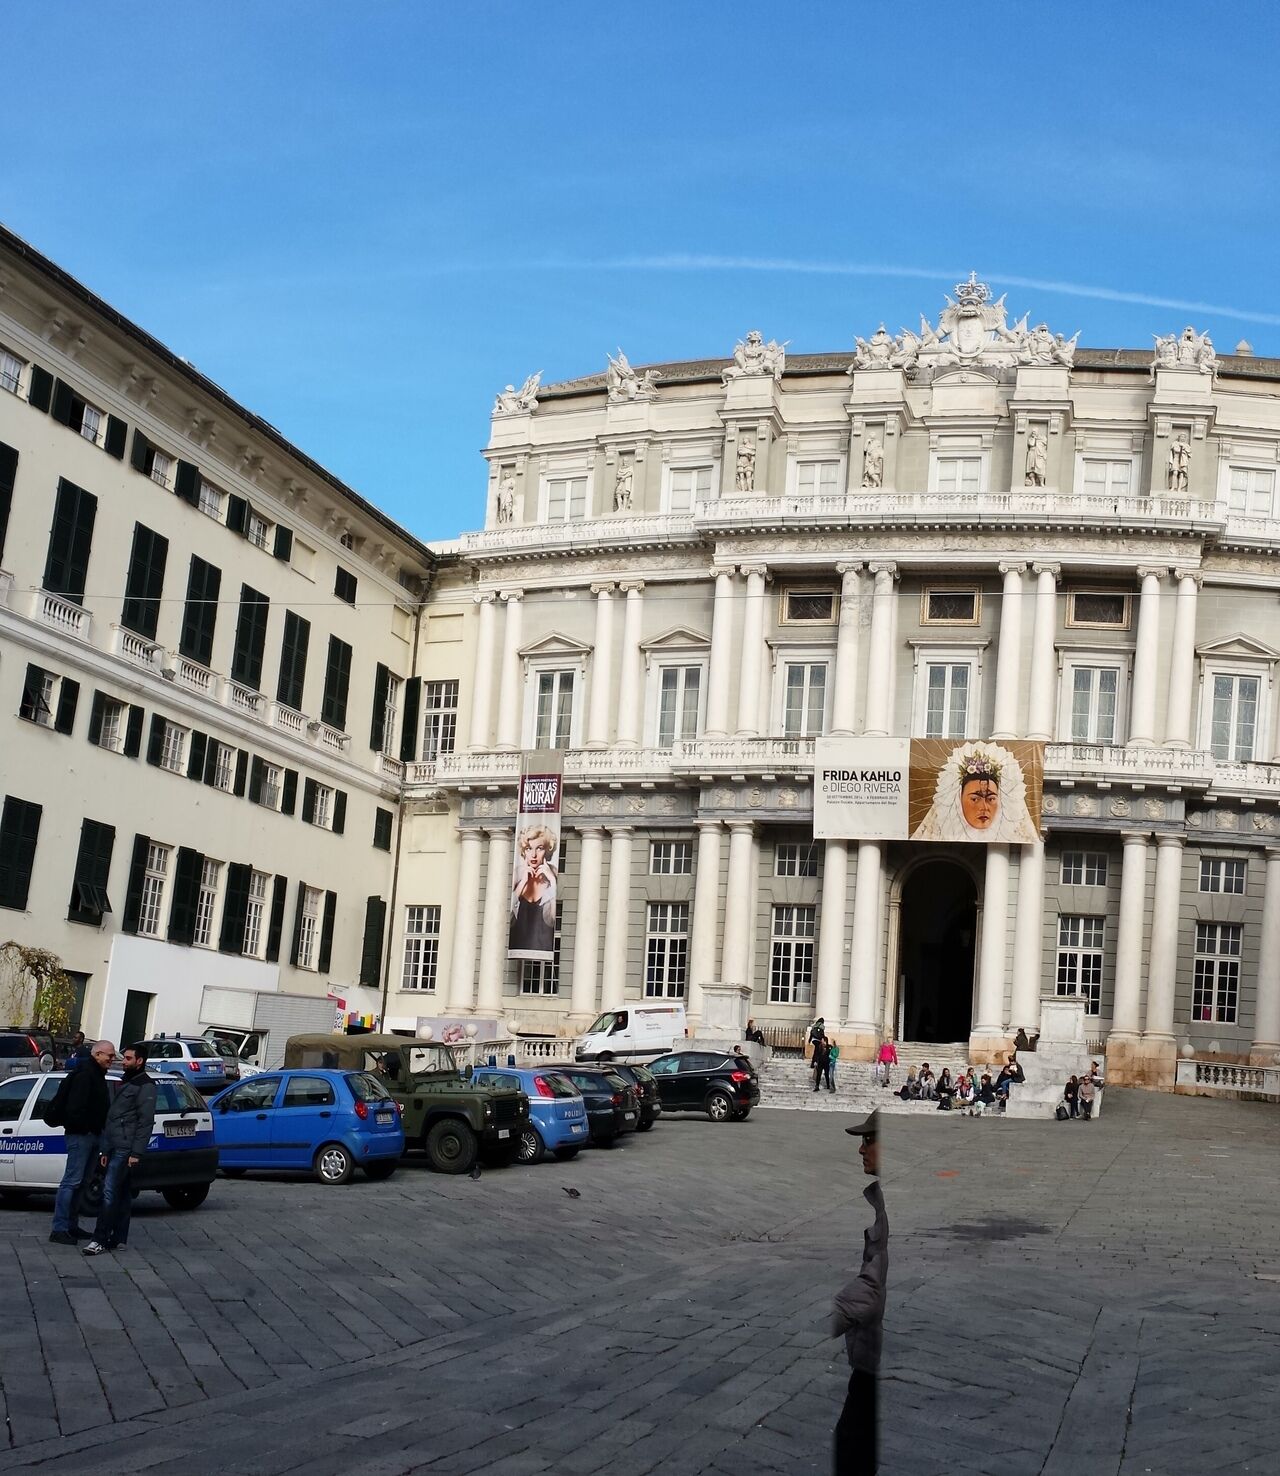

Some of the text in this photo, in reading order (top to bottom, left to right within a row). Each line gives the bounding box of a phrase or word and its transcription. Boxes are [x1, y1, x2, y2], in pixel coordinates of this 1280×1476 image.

[823, 770, 901, 782] FRIDA KAHLO
[523, 782, 558, 792] NICKOLAS
[822, 782, 901, 793] e DIEGO RIVERA
[523, 791, 557, 804] MURAY
[0, 1139, 44, 1153] Municipale
